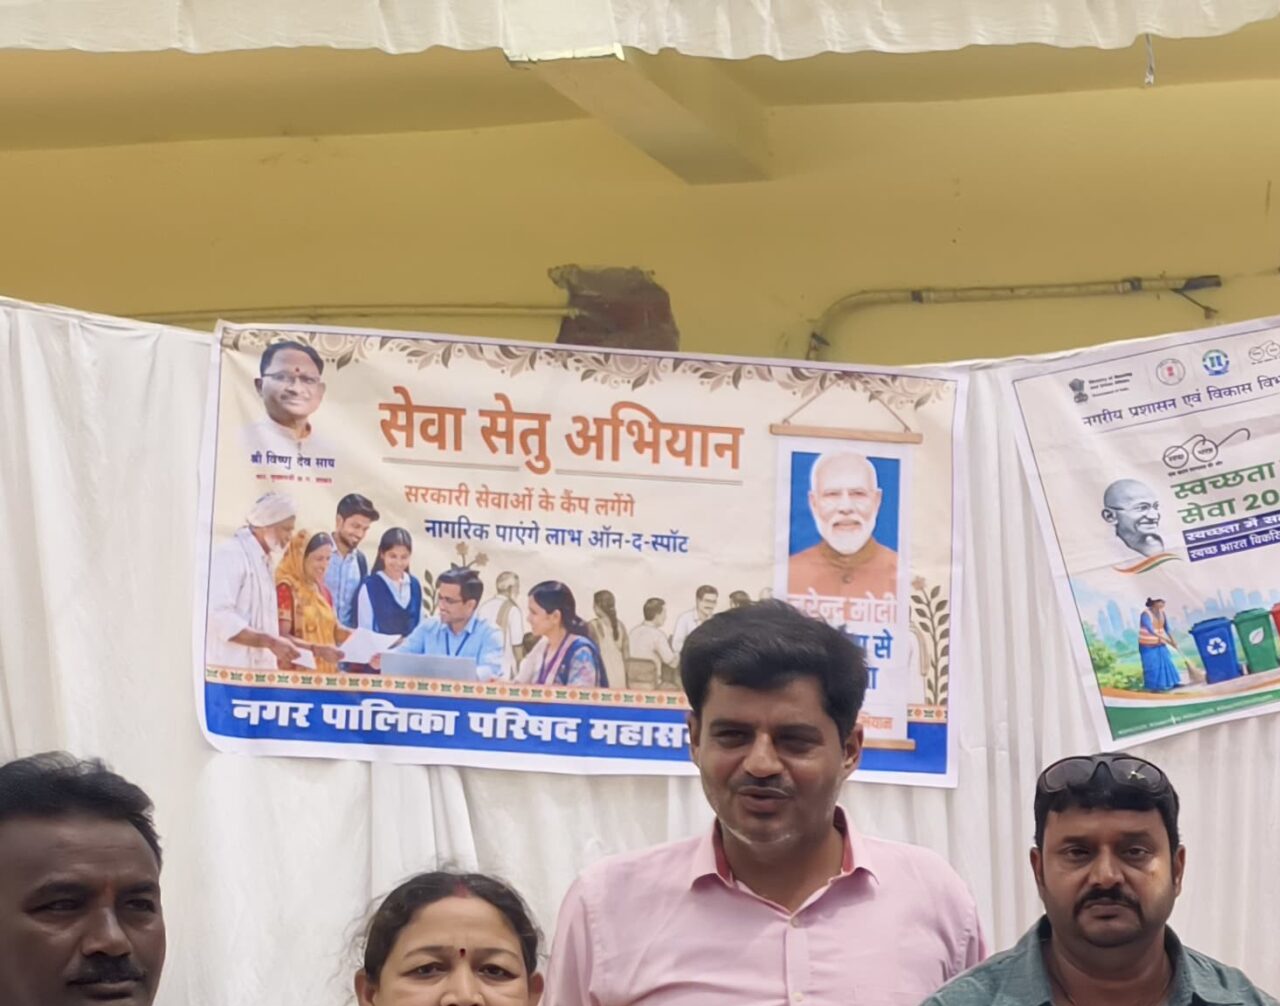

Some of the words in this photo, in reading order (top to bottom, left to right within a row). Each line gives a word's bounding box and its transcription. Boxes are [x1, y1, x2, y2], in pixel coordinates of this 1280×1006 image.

[1082, 409, 1123, 428] नगरीय
[1128, 398, 1178, 419] प्रशासन
[1181, 388, 1201, 407] एवं
[1206, 382, 1253, 401] विकास
[378, 385, 467, 451] सेवा
[479, 392, 551, 475] सेतु
[564, 400, 744, 470] अभियान
[1171, 462, 1275, 499] स्वच्छता
[404, 482, 470, 508] सरकारी
[475, 484, 535, 512] सेवाओं
[538, 487, 556, 512] के
[560, 489, 590, 515] कैंप
[594, 493, 635, 518] लगेंगे
[1177, 498, 1236, 525] सेवा
[424, 515, 490, 541] नागरिक
[495, 520, 540, 545] पाएंगे
[545, 527, 582, 547] लाभ
[588, 525, 690, 553] ऑन-द-स्पॉट
[1221, 539, 1248, 553] भारत
[847, 591, 897, 622] मोदी
[872, 628, 893, 659] से
[232, 698, 313, 729] नगर
[321, 697, 459, 736] पालिका
[468, 707, 581, 743] परिषद
[589, 718, 691, 748] महास
